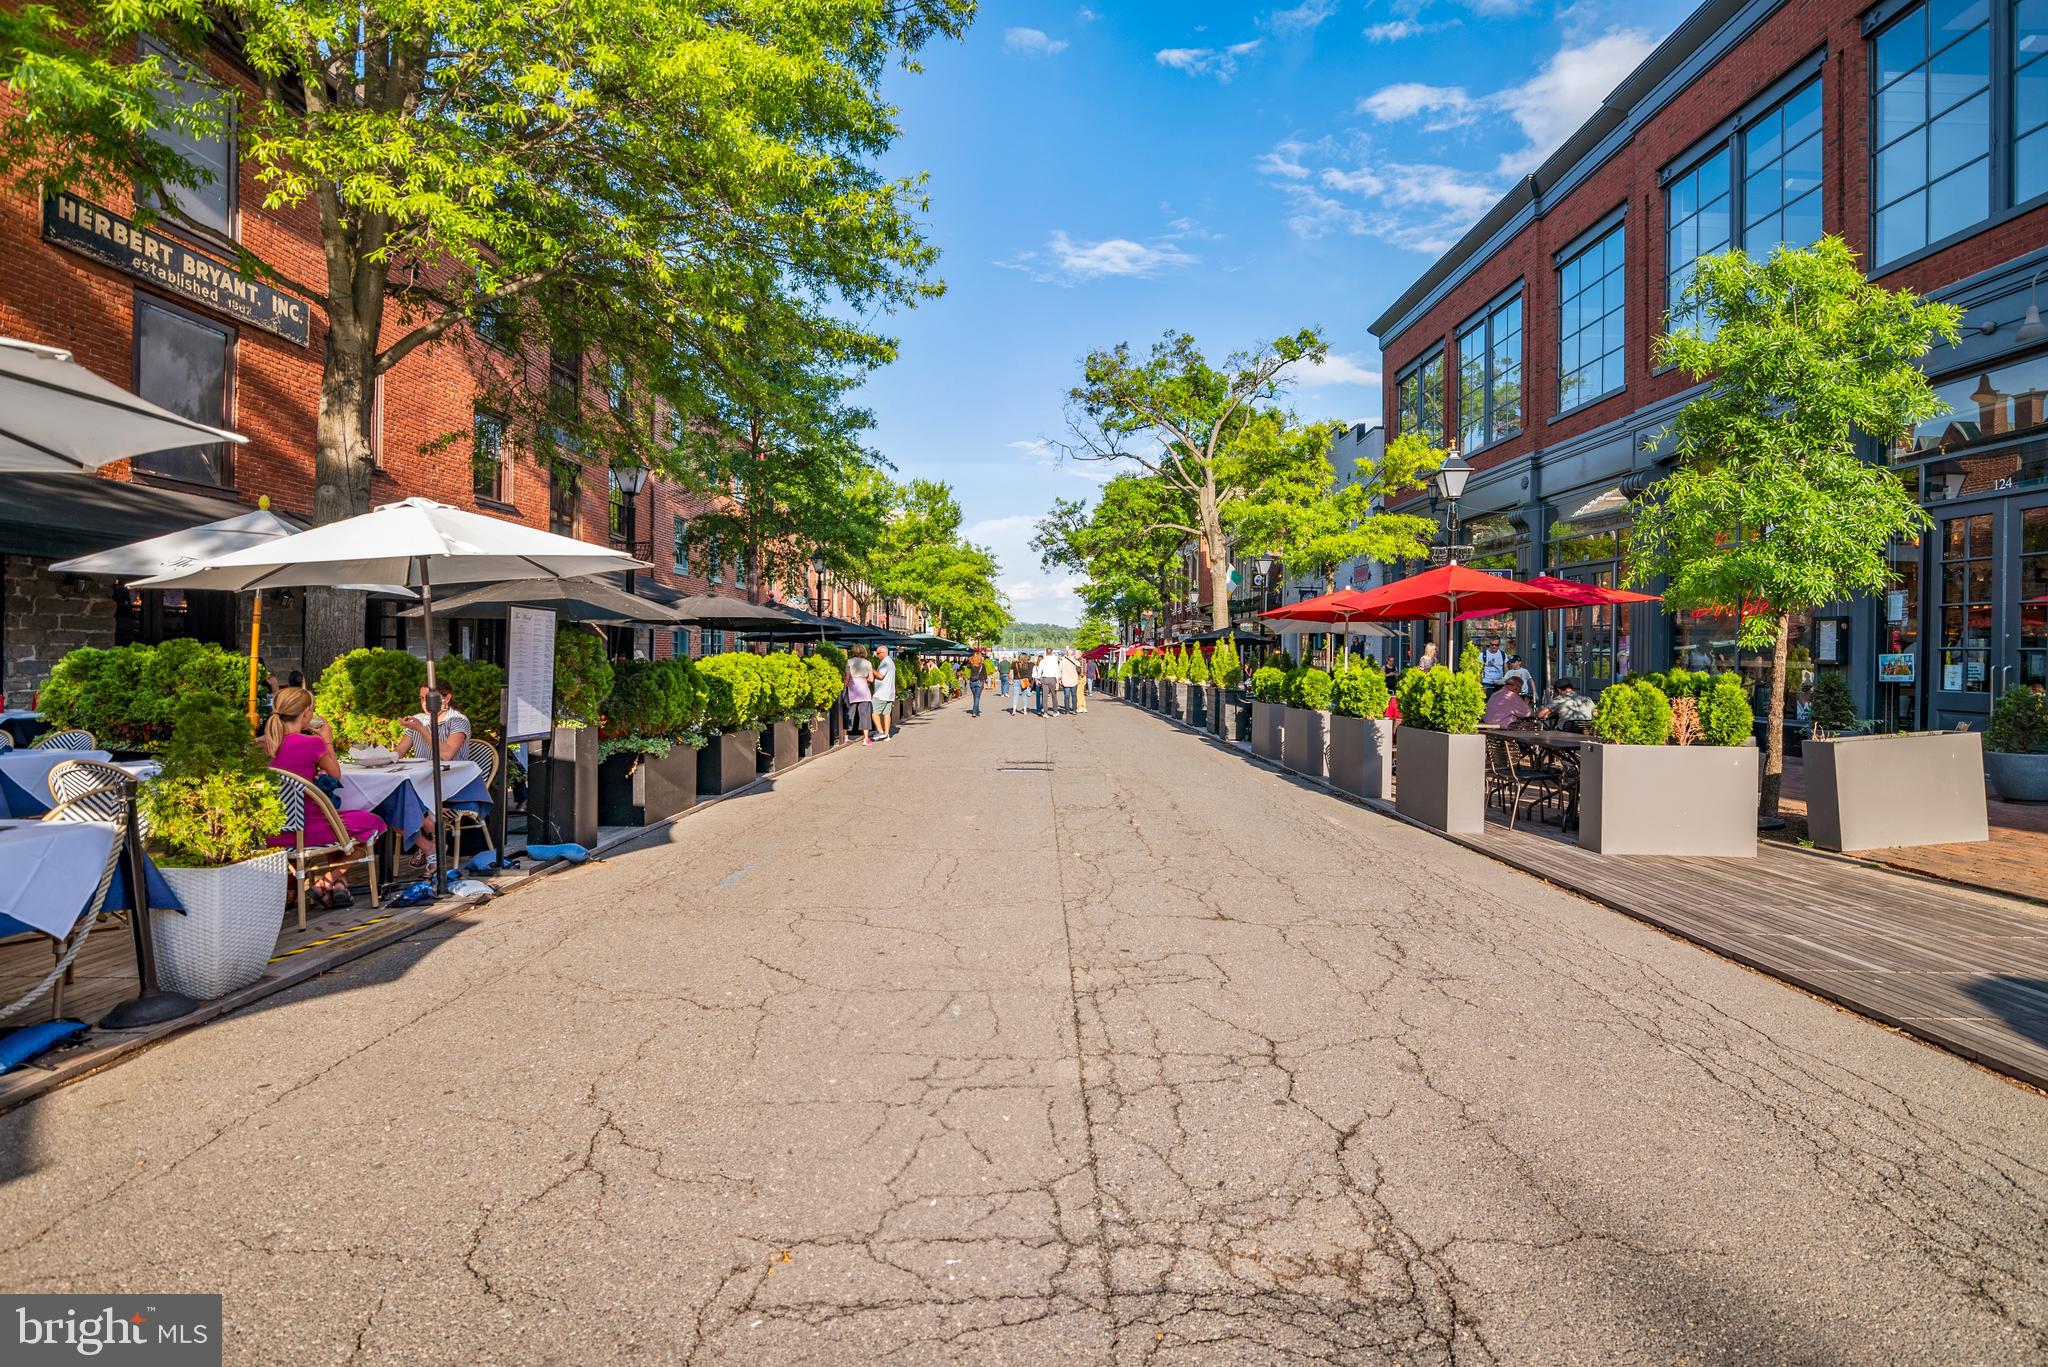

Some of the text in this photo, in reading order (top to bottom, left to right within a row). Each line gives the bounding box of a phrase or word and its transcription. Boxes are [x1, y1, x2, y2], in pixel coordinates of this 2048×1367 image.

[58, 196, 174, 265] HERBERT
[272, 294, 304, 325] INC.
[132, 256, 219, 303] established
[1994, 476, 2013, 491] 124
